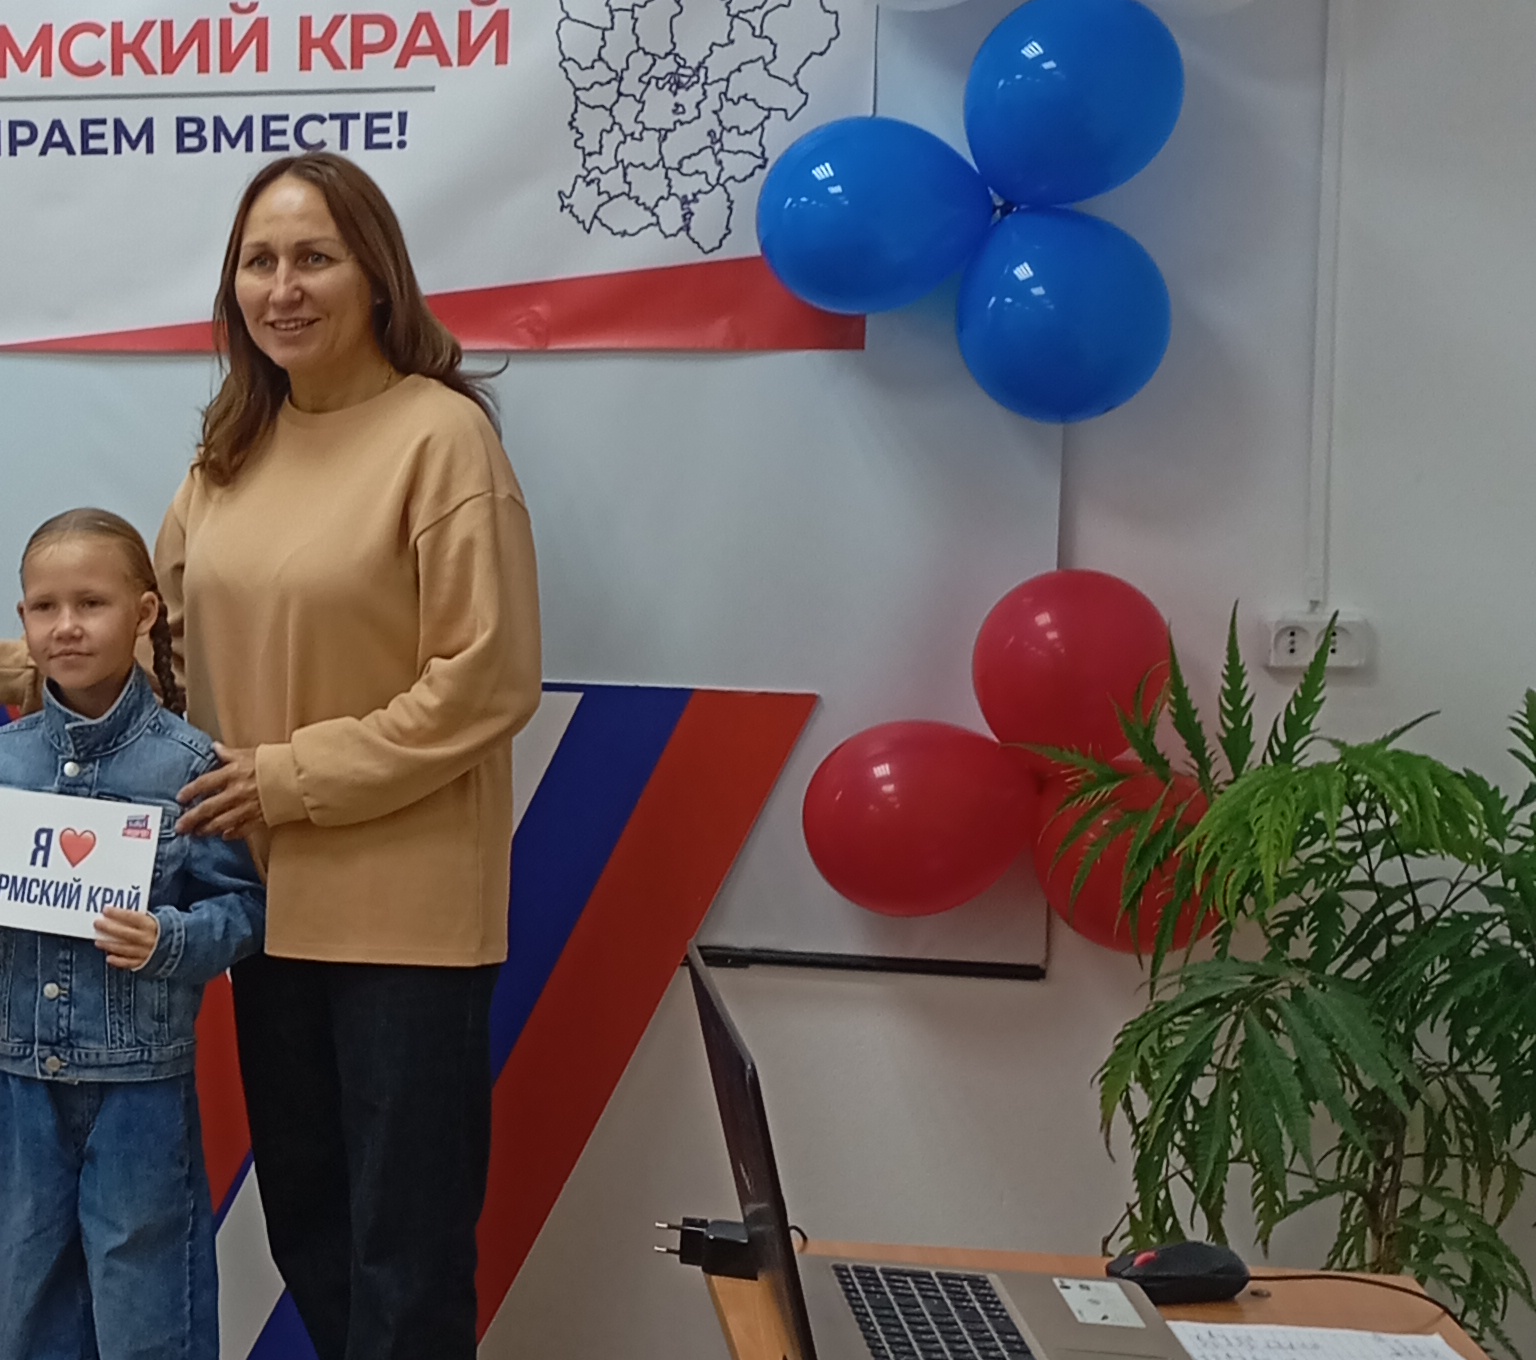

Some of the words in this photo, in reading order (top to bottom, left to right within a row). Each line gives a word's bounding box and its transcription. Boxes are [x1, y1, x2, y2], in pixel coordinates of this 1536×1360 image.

[174, 111, 409, 155] ВМЕСТЕ!
[29, 827, 54, 868] Я
[85, 885, 141, 914] КРАЙ
